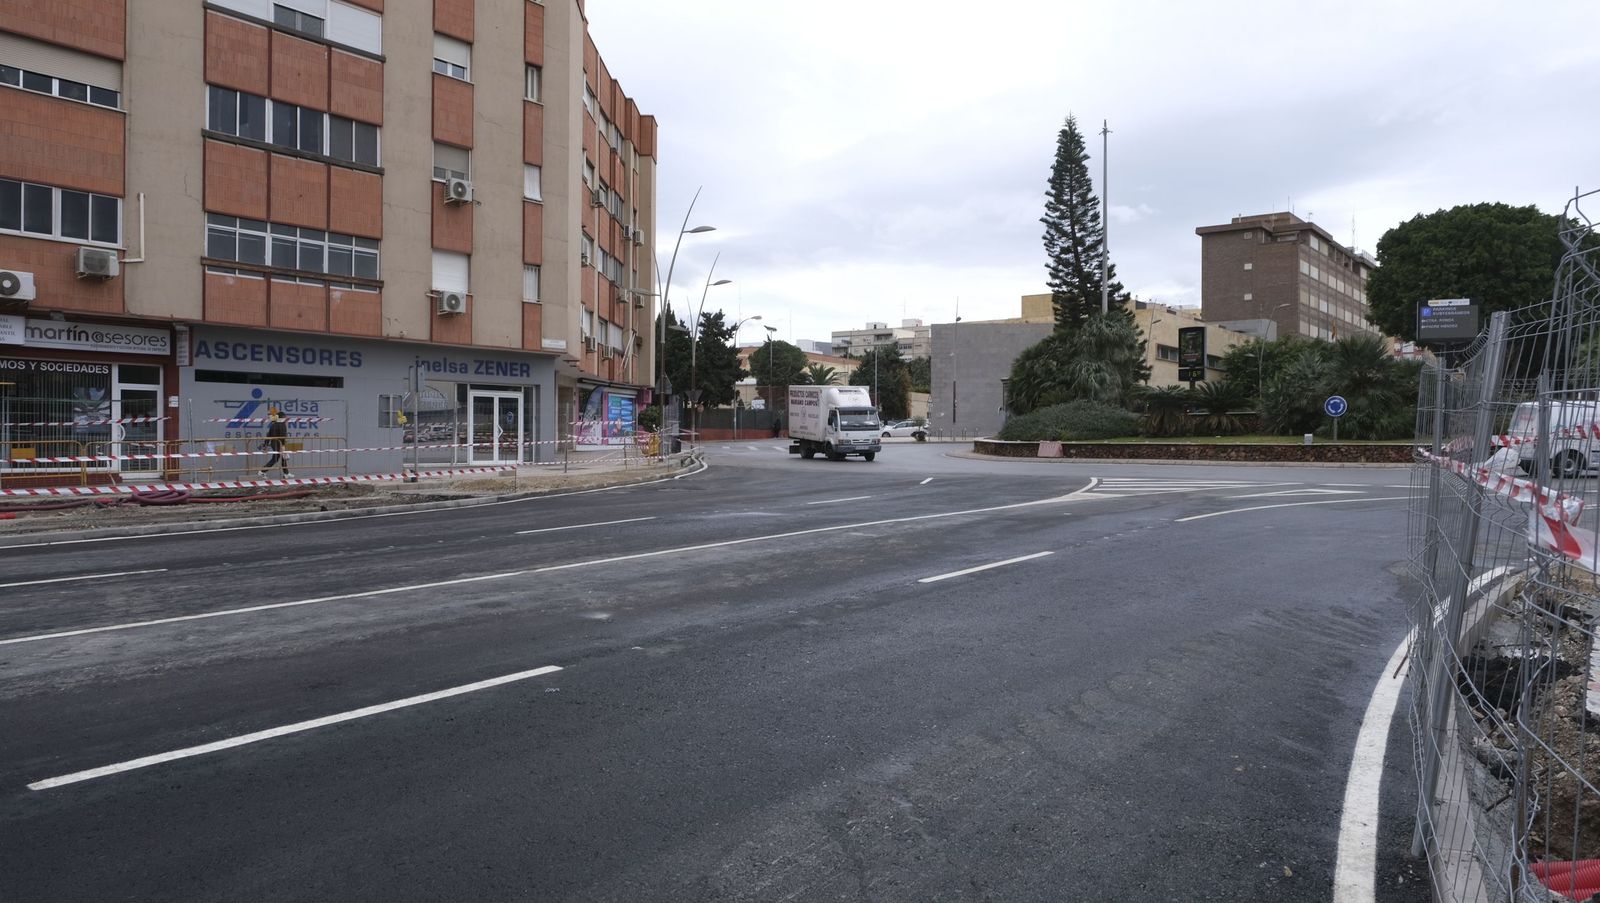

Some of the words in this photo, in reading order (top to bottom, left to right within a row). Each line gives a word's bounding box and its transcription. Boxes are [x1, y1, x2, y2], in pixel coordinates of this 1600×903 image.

[25, 325, 90, 342] martín
[194, 340, 363, 368] ASCENSORES
[29, 362, 38, 370] Y
[40, 362, 109, 374] SOCIEDADES
[415, 355, 468, 374] inelsa
[474, 360, 531, 378] ZENER
